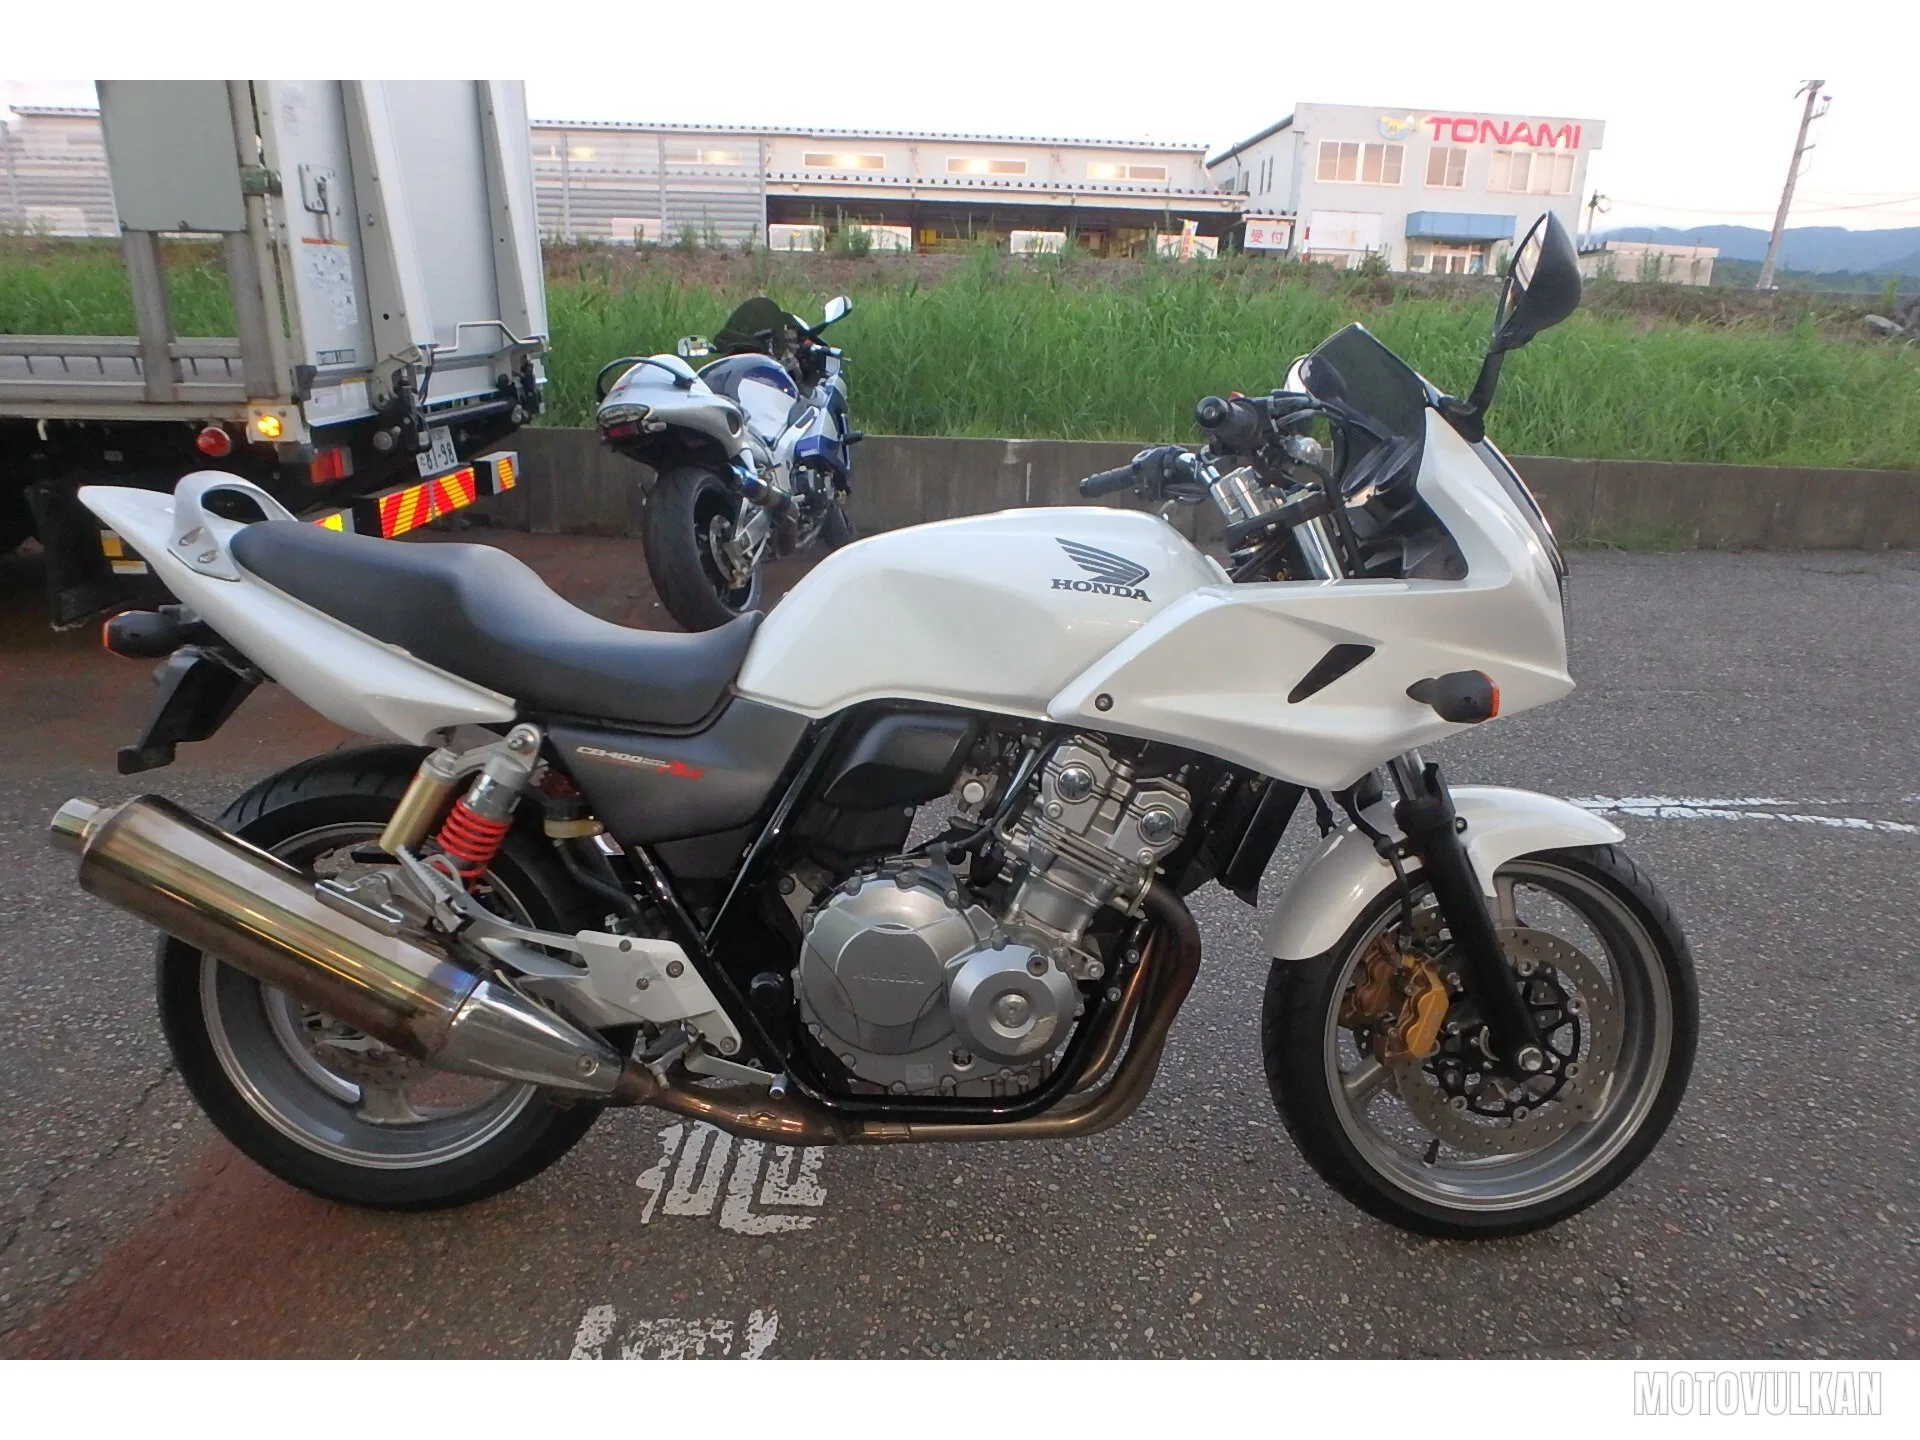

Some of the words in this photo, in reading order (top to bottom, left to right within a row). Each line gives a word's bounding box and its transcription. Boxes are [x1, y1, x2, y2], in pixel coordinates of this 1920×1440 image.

[1426, 116, 1582, 149] TONAMI
[1250, 229, 1284, 244] 受付
[1051, 579, 1152, 603] HONDA
